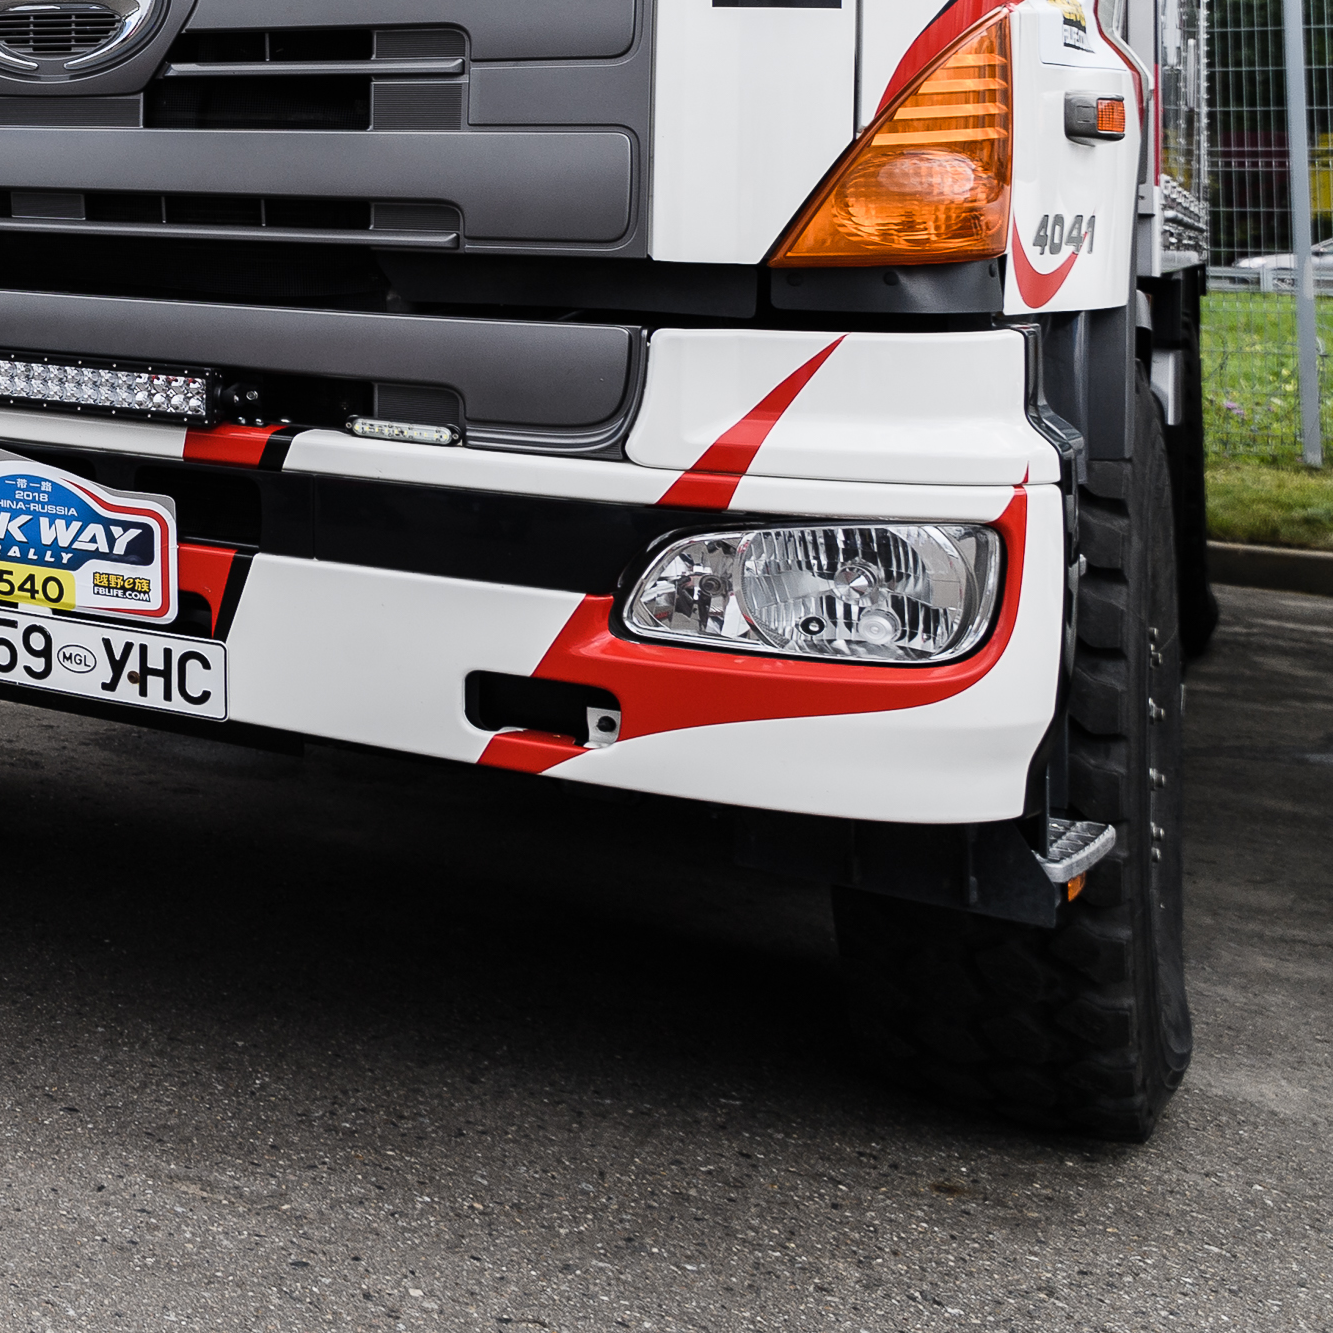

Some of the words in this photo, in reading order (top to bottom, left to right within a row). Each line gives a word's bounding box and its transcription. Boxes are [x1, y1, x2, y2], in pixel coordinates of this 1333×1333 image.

[1032, 213, 1096, 256] 4041
[4, 477, 52, 493] 一带一路
[14, 490, 49, 503] 2018
[39, 516, 143, 555] WAY
[93, 571, 151, 593] 越野e族
[94, 586, 151, 602] FBLIFE.COM
[61, 651, 92, 668] MGL
